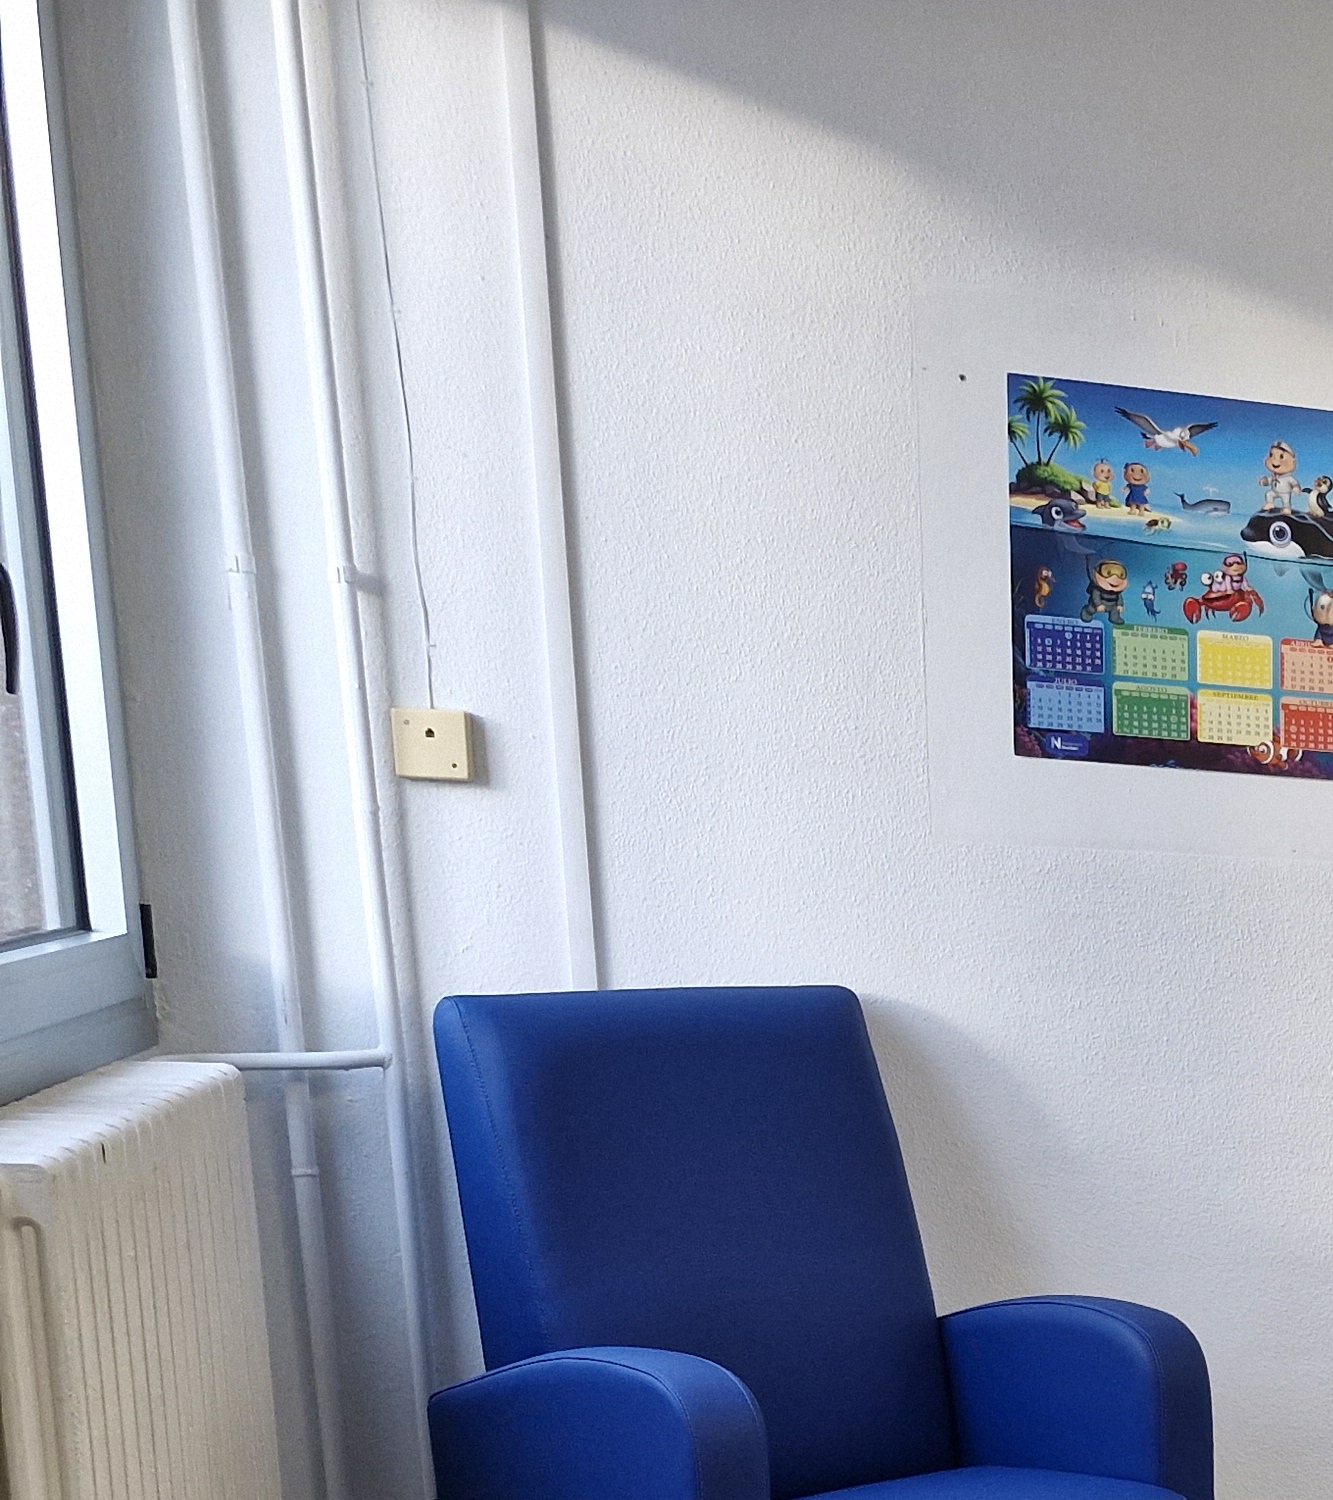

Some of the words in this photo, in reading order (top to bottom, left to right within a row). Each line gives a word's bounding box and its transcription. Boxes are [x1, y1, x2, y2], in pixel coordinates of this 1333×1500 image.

[1222, 633, 1249, 641] MARZO
[1055, 677, 1078, 685] JULIO
[1135, 685, 1168, 693] AGOSTO
[1213, 691, 1259, 701] SEPTIEMBRE
